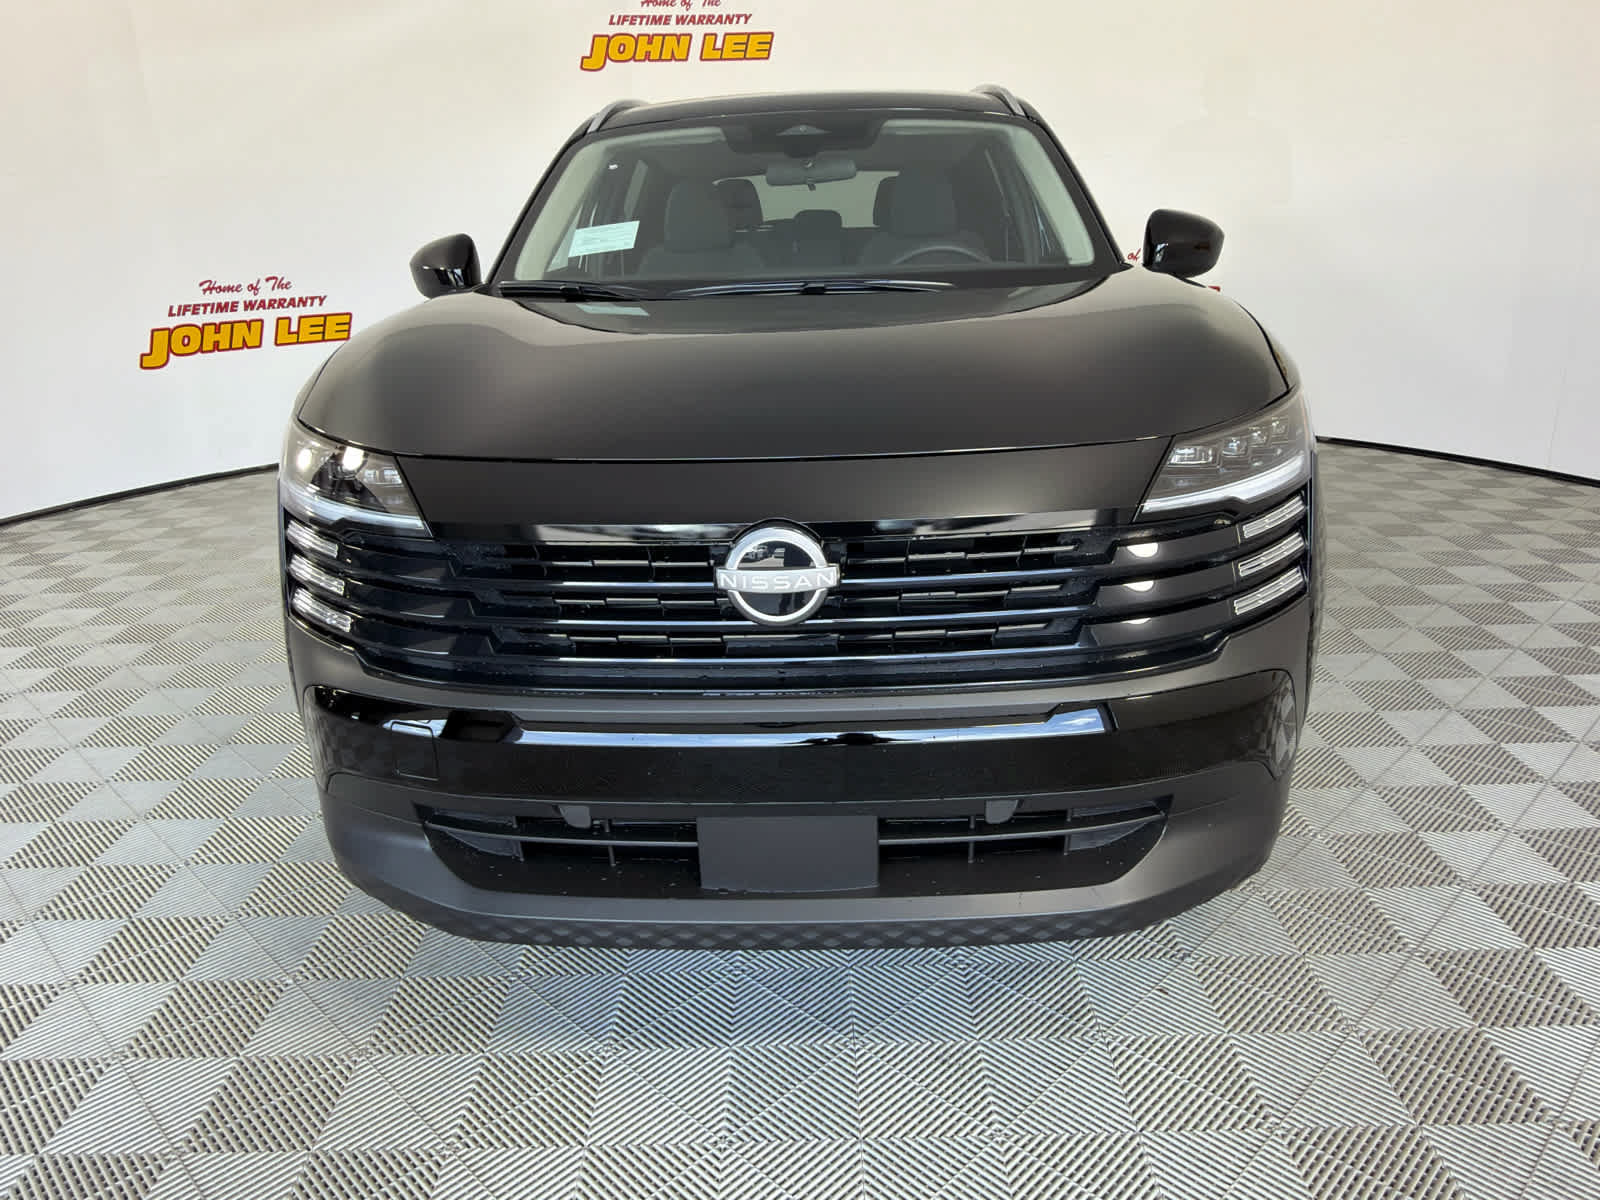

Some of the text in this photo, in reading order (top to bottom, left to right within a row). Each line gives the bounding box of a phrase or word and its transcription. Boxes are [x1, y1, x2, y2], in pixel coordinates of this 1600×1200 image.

[609, 13, 753, 26] LIFETIME WARRANTY
[580, 31, 774, 72] JOHN LEE
[199, 276, 292, 296] Home of The
[168, 295, 327, 317] LIFETIME WARRANTY
[139, 312, 352, 370] JOHN LEE
[719, 570, 834, 590] NISSAN
